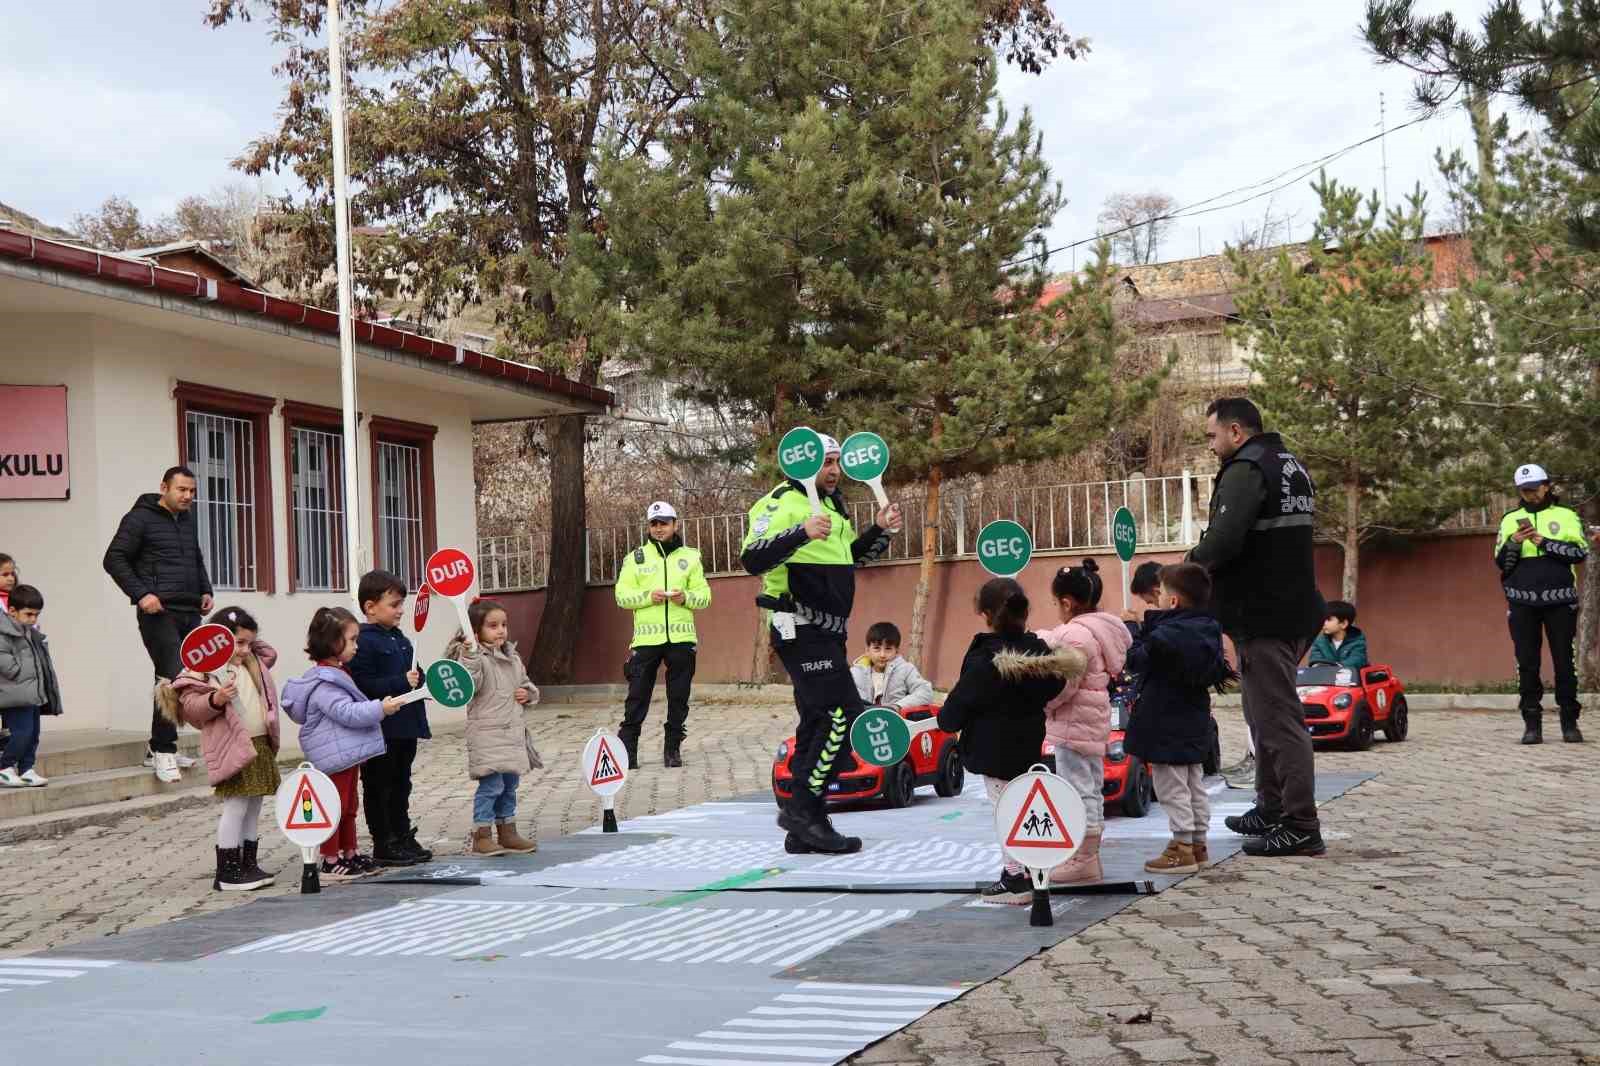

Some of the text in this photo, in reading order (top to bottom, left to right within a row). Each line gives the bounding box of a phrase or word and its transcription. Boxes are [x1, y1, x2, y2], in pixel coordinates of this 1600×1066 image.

[0, 454, 63, 476] KULU
[782, 441, 817, 465] GEÇ
[843, 445, 881, 467] GEÇ
[1115, 523, 1134, 548] GEÇ
[982, 537, 1024, 559] GEÇ
[430, 560, 470, 583] DUR
[187, 633, 230, 665] DUR
[438, 664, 464, 701] GEÇ
[865, 716, 893, 762] GEÇ
